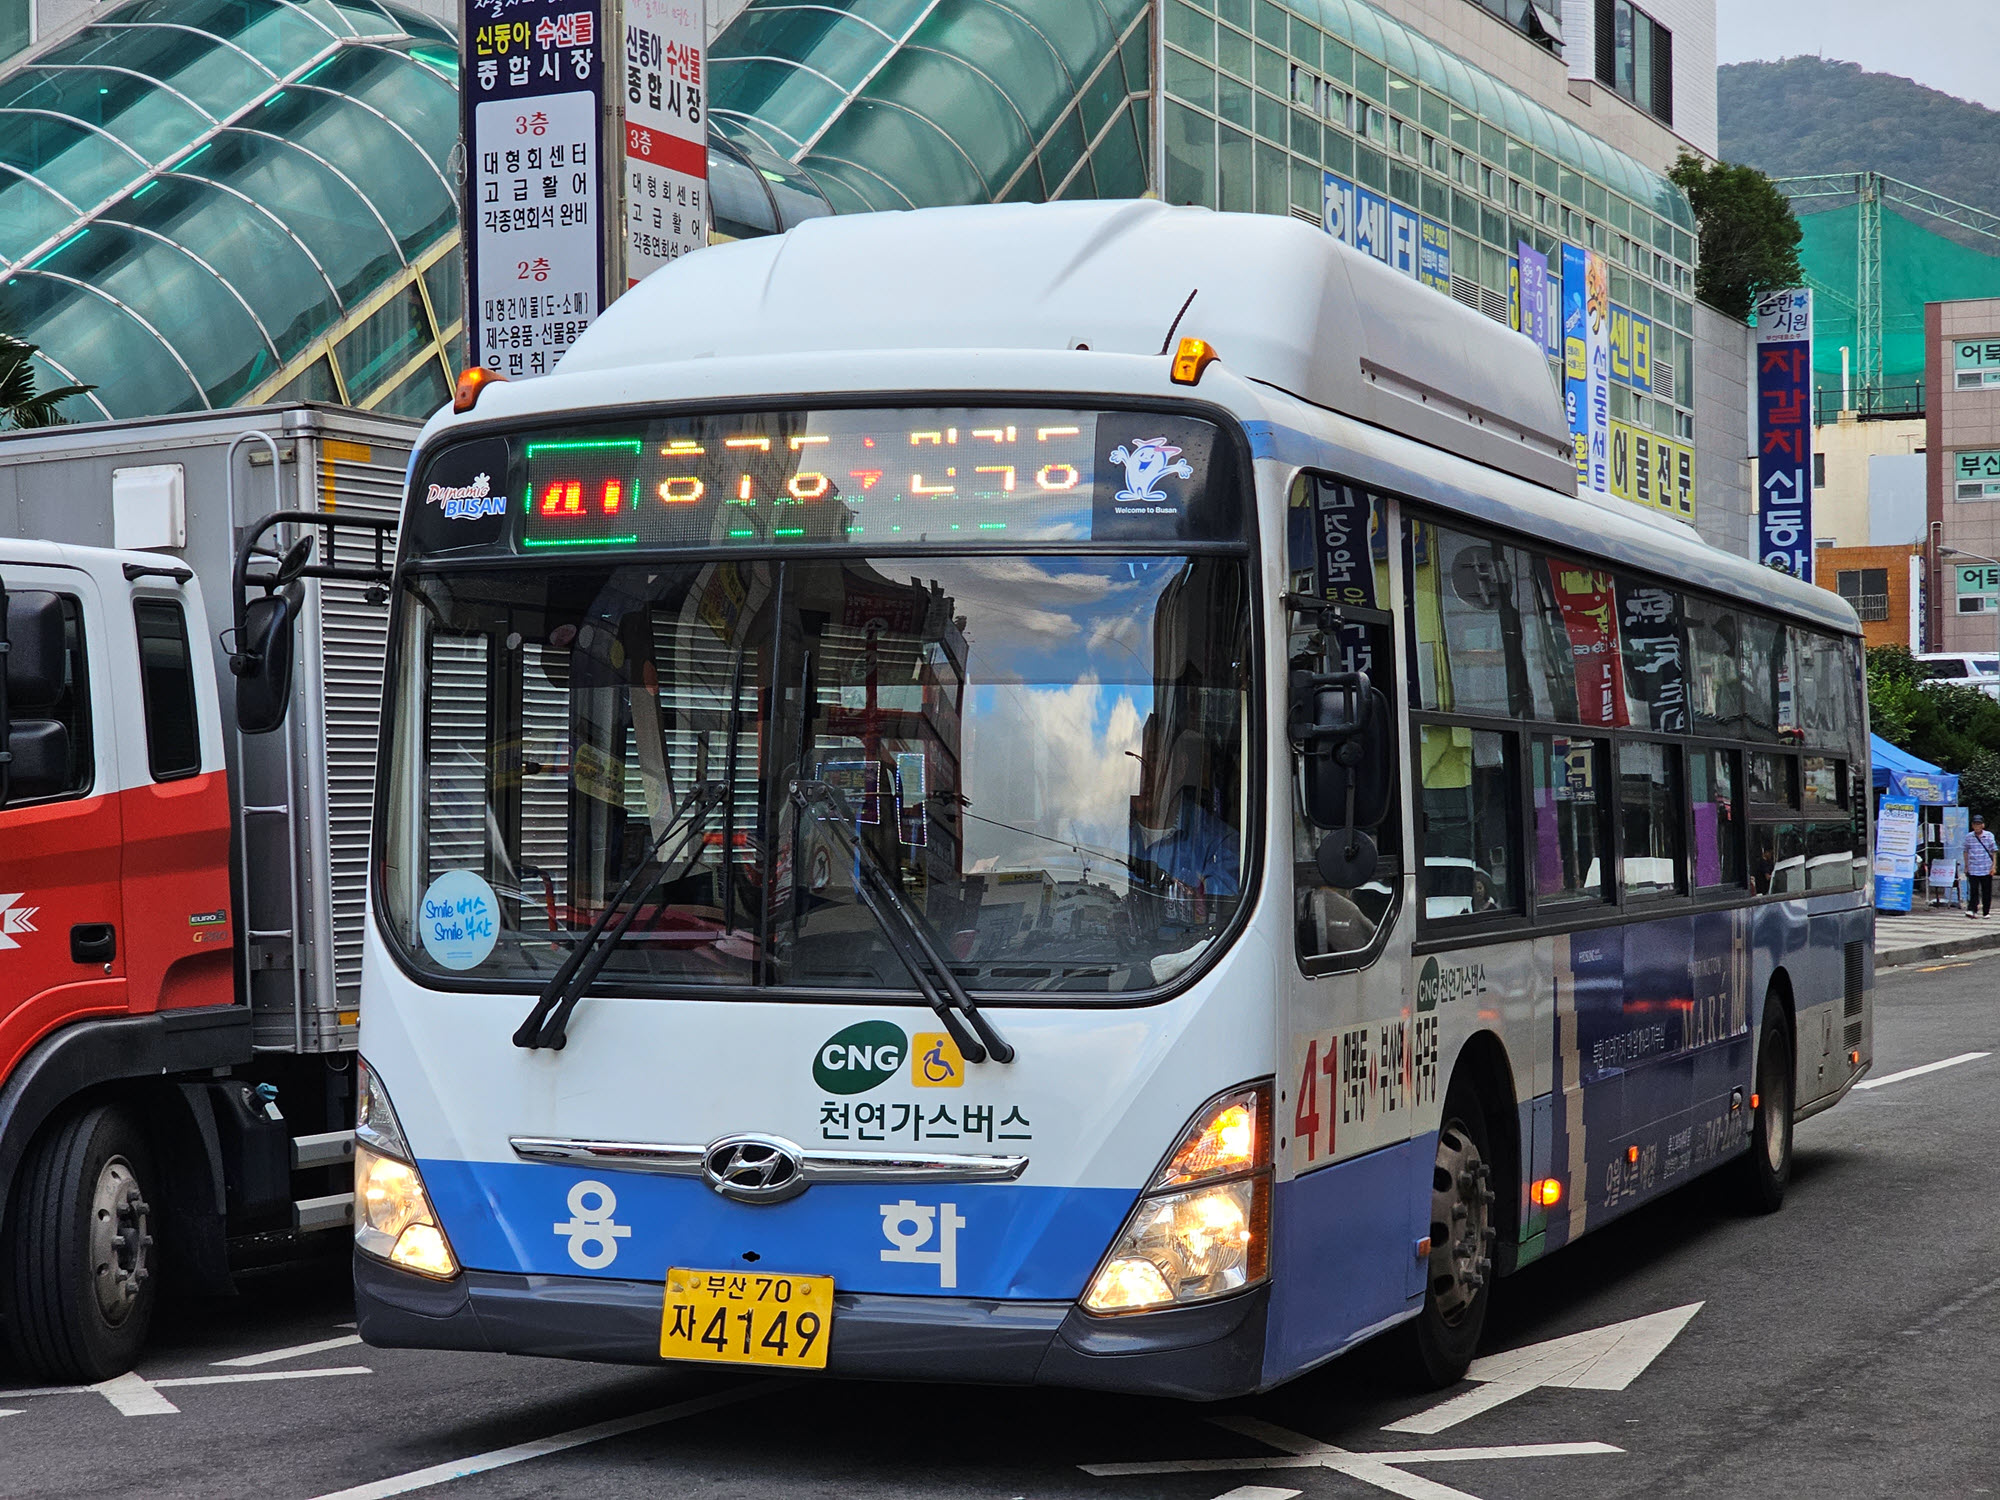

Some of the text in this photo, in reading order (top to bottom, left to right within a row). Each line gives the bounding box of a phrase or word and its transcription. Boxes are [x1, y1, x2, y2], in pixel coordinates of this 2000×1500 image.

[476, 10, 594, 55] 신동아 수산물
[477, 49, 594, 90] 종합시장
[626, 24, 700, 85] 신동아 수산물
[627, 64, 700, 123] 종합시장
[515, 111, 549, 137] 3층
[484, 142, 586, 175] 대형회센터
[630, 129, 652, 156] 3층
[484, 202, 588, 234] 각종연회석 완비
[517, 257, 551, 282] 2층
[1758, 293, 1794, 316] 순한
[1773, 312, 1808, 333] 시원
[1609, 310, 1650, 386] 센터
[1761, 348, 1806, 464] 자갈치
[426, 484, 490, 510] Dynamic
[445, 497, 507, 517] BUSAN
[425, 896, 487, 919] Smile 버스
[434, 916, 493, 942] Smile 부산
[1419, 978, 1438, 1003] CNG
[1440, 964, 1487, 1003] 천연가스버스
[821, 1043, 900, 1072] CNG
[1343, 1016, 1438, 1124] 민락동 부산역 충무동
[1295, 1036, 1338, 1161] 41
[819, 1102, 1032, 1142] 천연가스버스
[553, 1180, 967, 1289] 용 화
[706, 1275, 792, 1303] 부산 70
